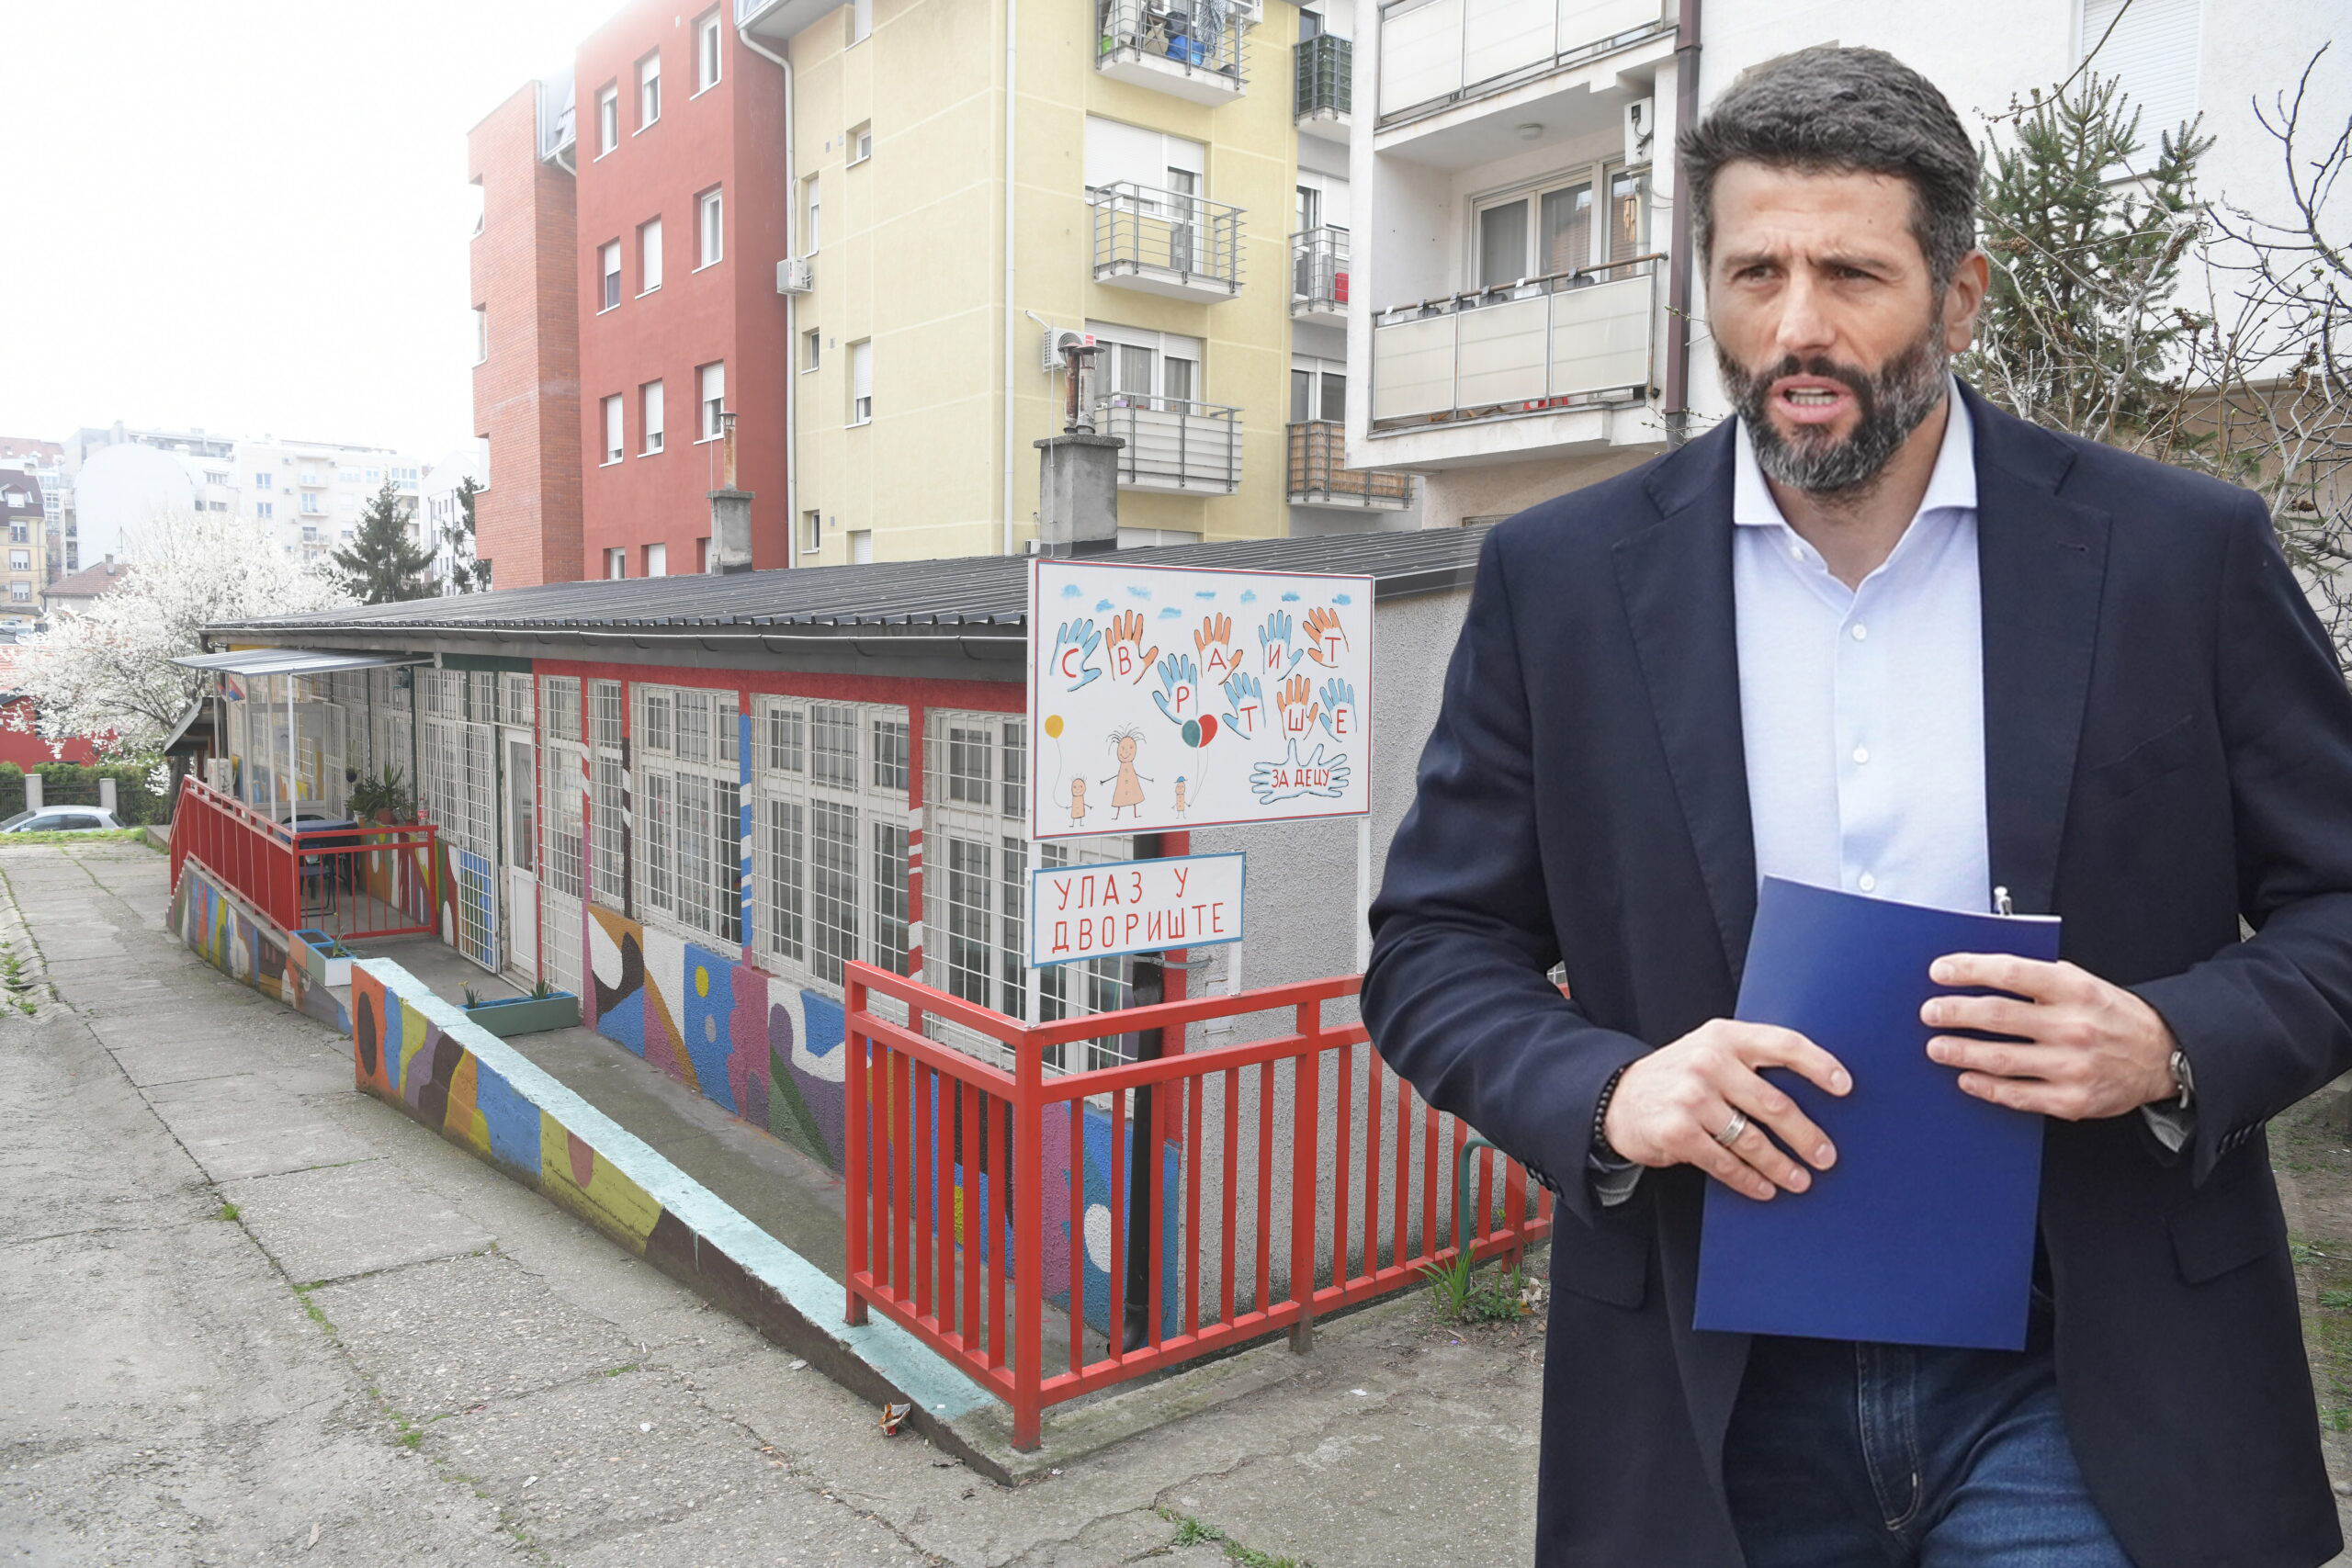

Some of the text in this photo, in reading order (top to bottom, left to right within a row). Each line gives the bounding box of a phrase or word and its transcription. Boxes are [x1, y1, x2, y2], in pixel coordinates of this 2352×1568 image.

[1272, 768, 1330, 788] ЗА ДЕЦУ
[1054, 867, 1189, 911] УЛАЗ У
[1052, 902, 1225, 953] ДВОРИШТЕ
